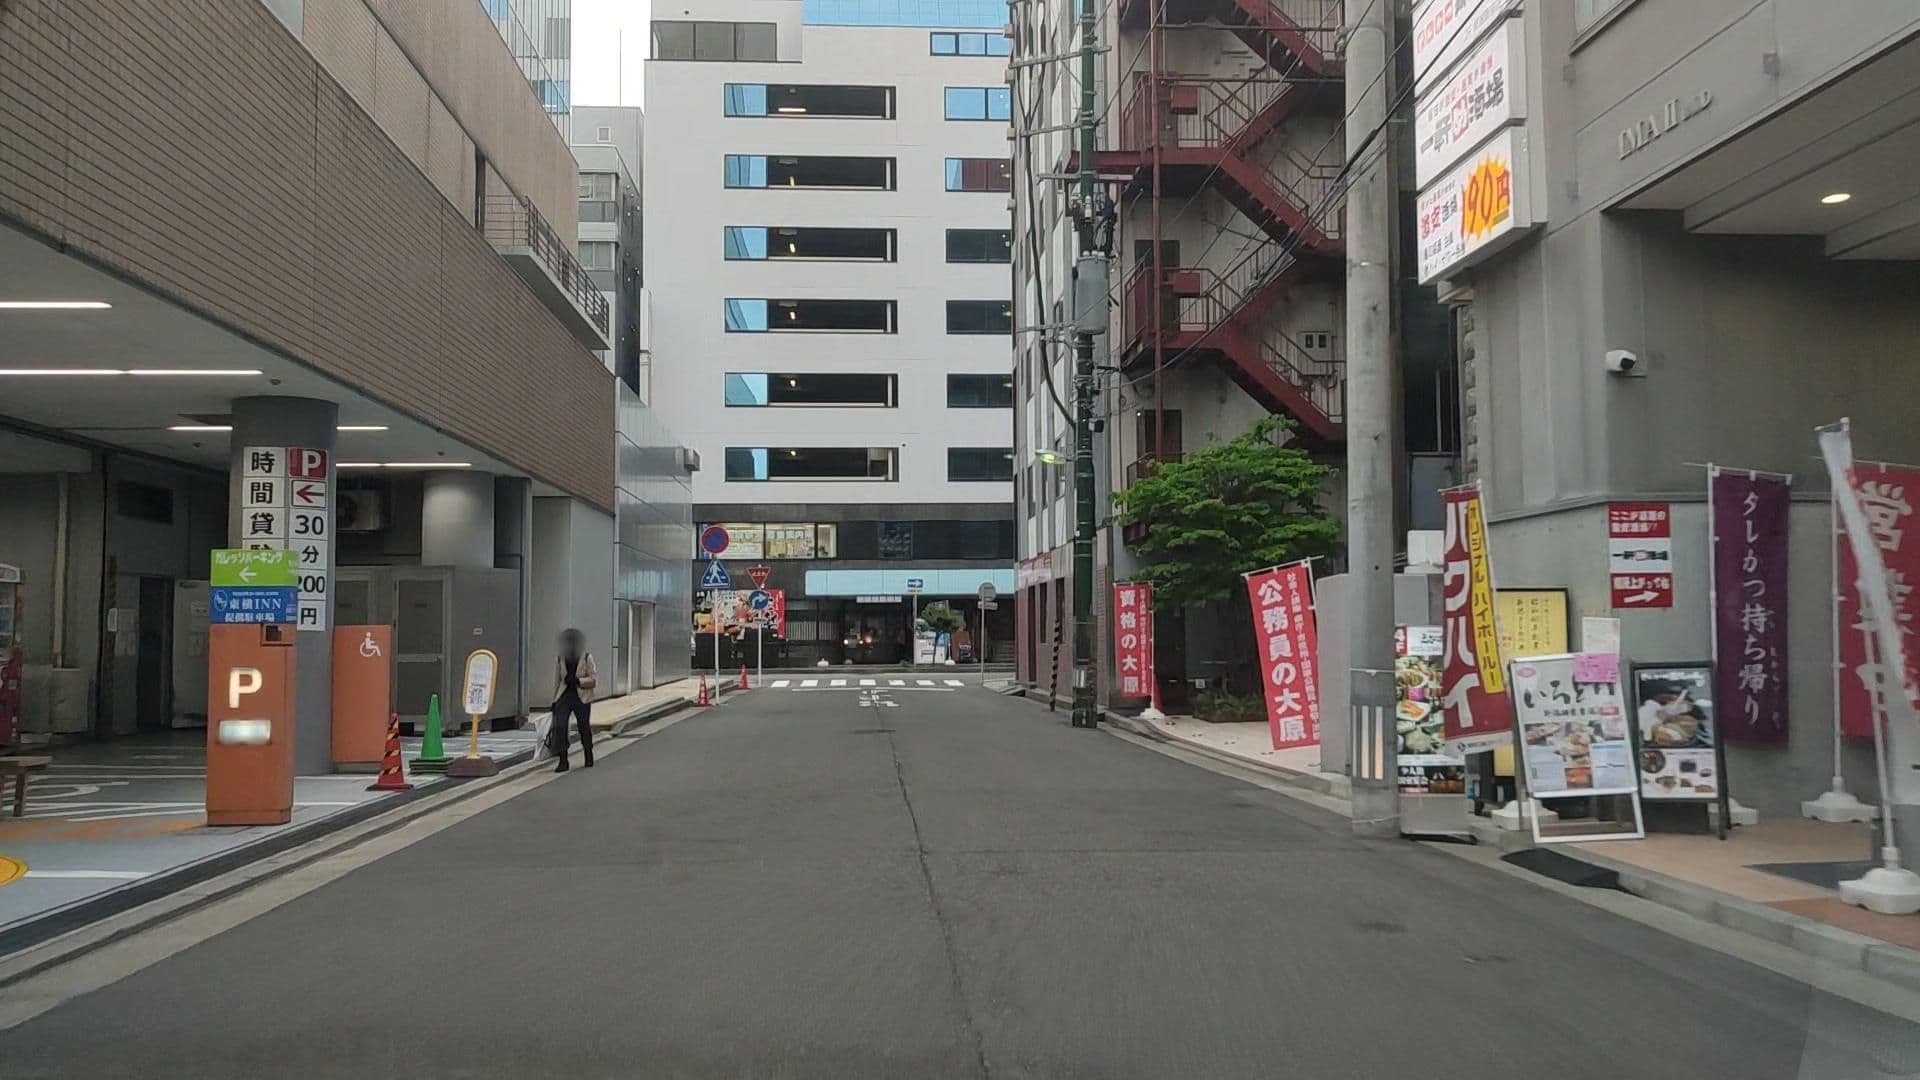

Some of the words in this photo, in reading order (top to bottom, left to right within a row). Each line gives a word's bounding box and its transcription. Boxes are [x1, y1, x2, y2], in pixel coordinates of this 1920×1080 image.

[1461, 164, 1511, 240] 190円
[249, 451, 275, 549] 時間貸
[301, 451, 321, 476] P
[1120, 588, 1139, 693] 資格の大原
[1738, 492, 1768, 725] タレかつ持ち帰り
[228, 667, 264, 709] P
[1257, 578, 1307, 743] 公務員の大原
